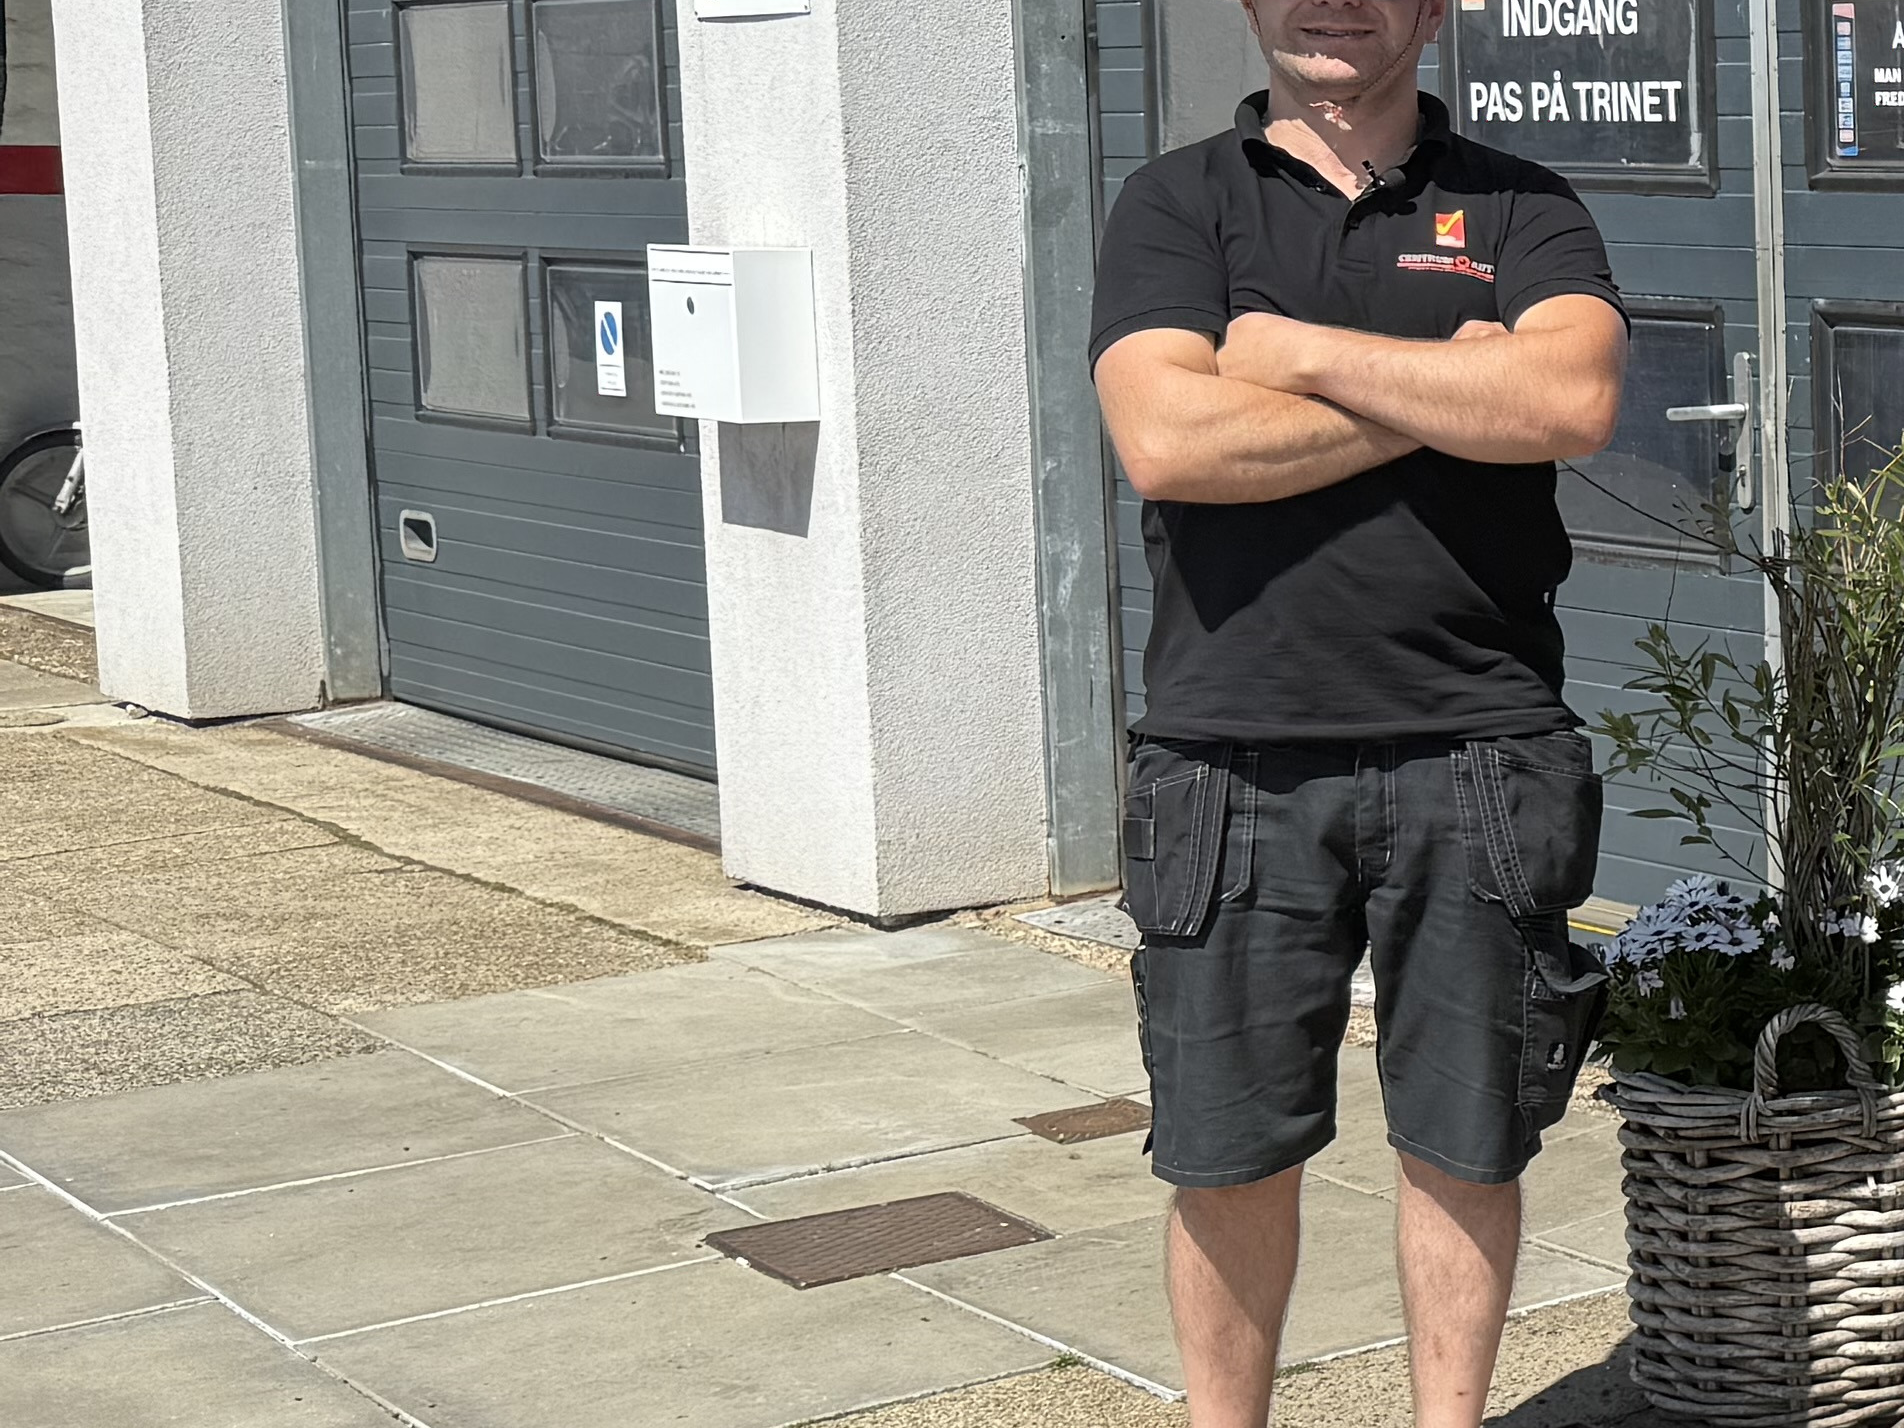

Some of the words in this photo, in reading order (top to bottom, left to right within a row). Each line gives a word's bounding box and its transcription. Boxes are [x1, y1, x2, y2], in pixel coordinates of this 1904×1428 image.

[1874, 67, 1901, 83] MAN
[1470, 81, 1523, 123] PAS
[1531, 70, 1570, 122] PÅ
[1572, 80, 1682, 122] TRINET
